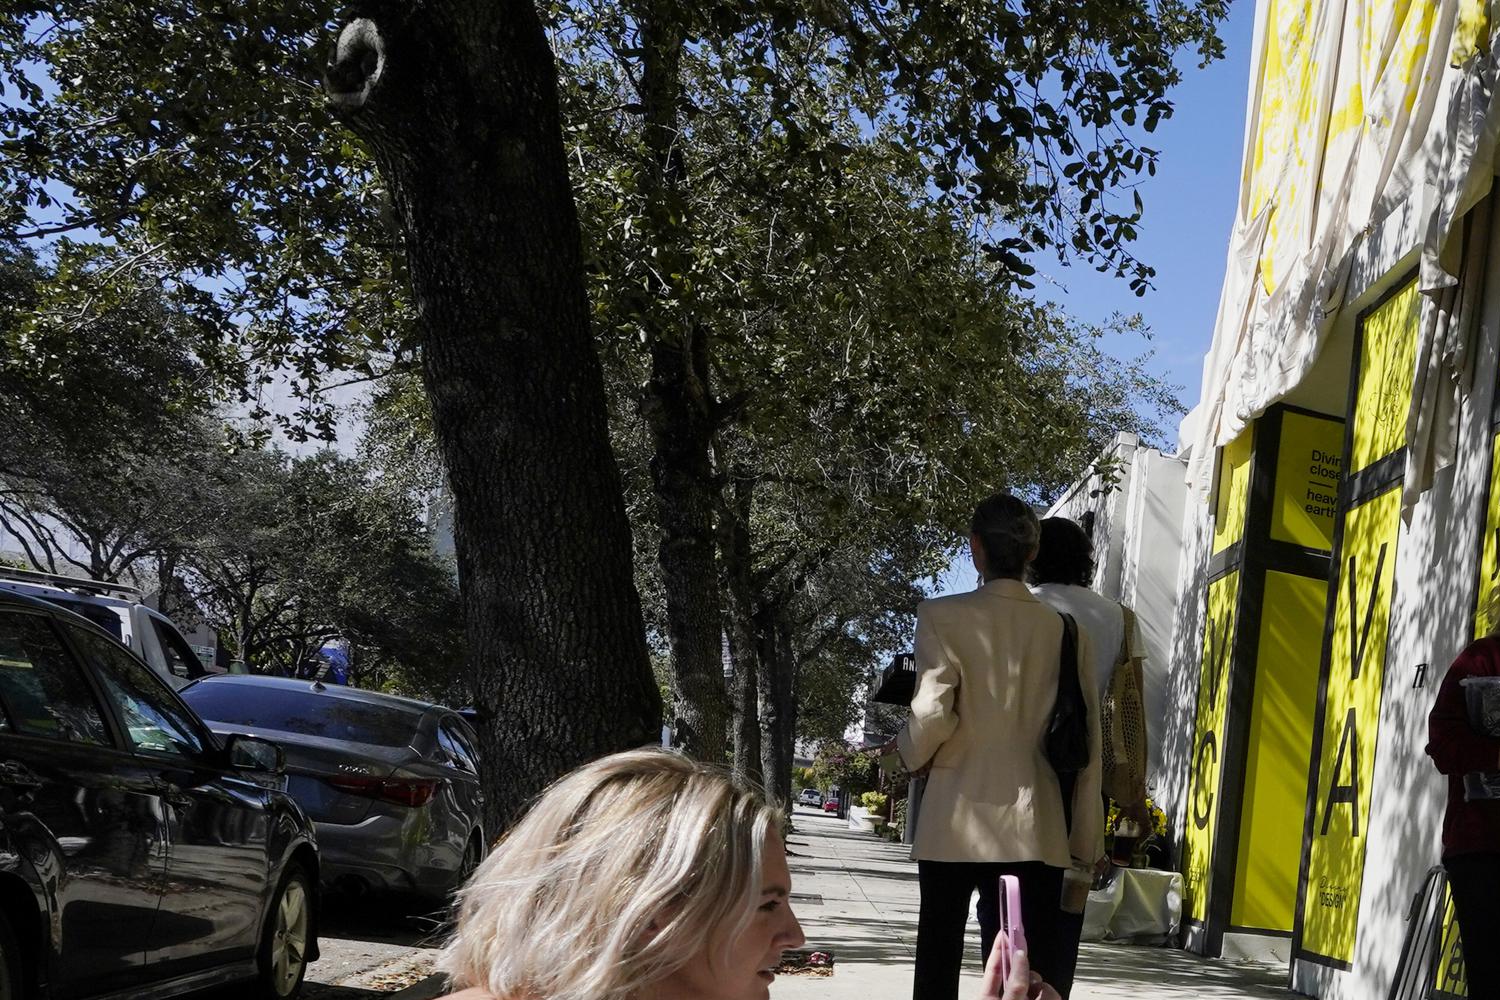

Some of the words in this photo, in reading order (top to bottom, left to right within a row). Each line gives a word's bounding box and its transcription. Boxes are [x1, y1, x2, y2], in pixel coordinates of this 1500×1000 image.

[1311, 449, 1341, 467] Divin
[1310, 464, 1342, 480] close
[1306, 488, 1338, 506] heav
